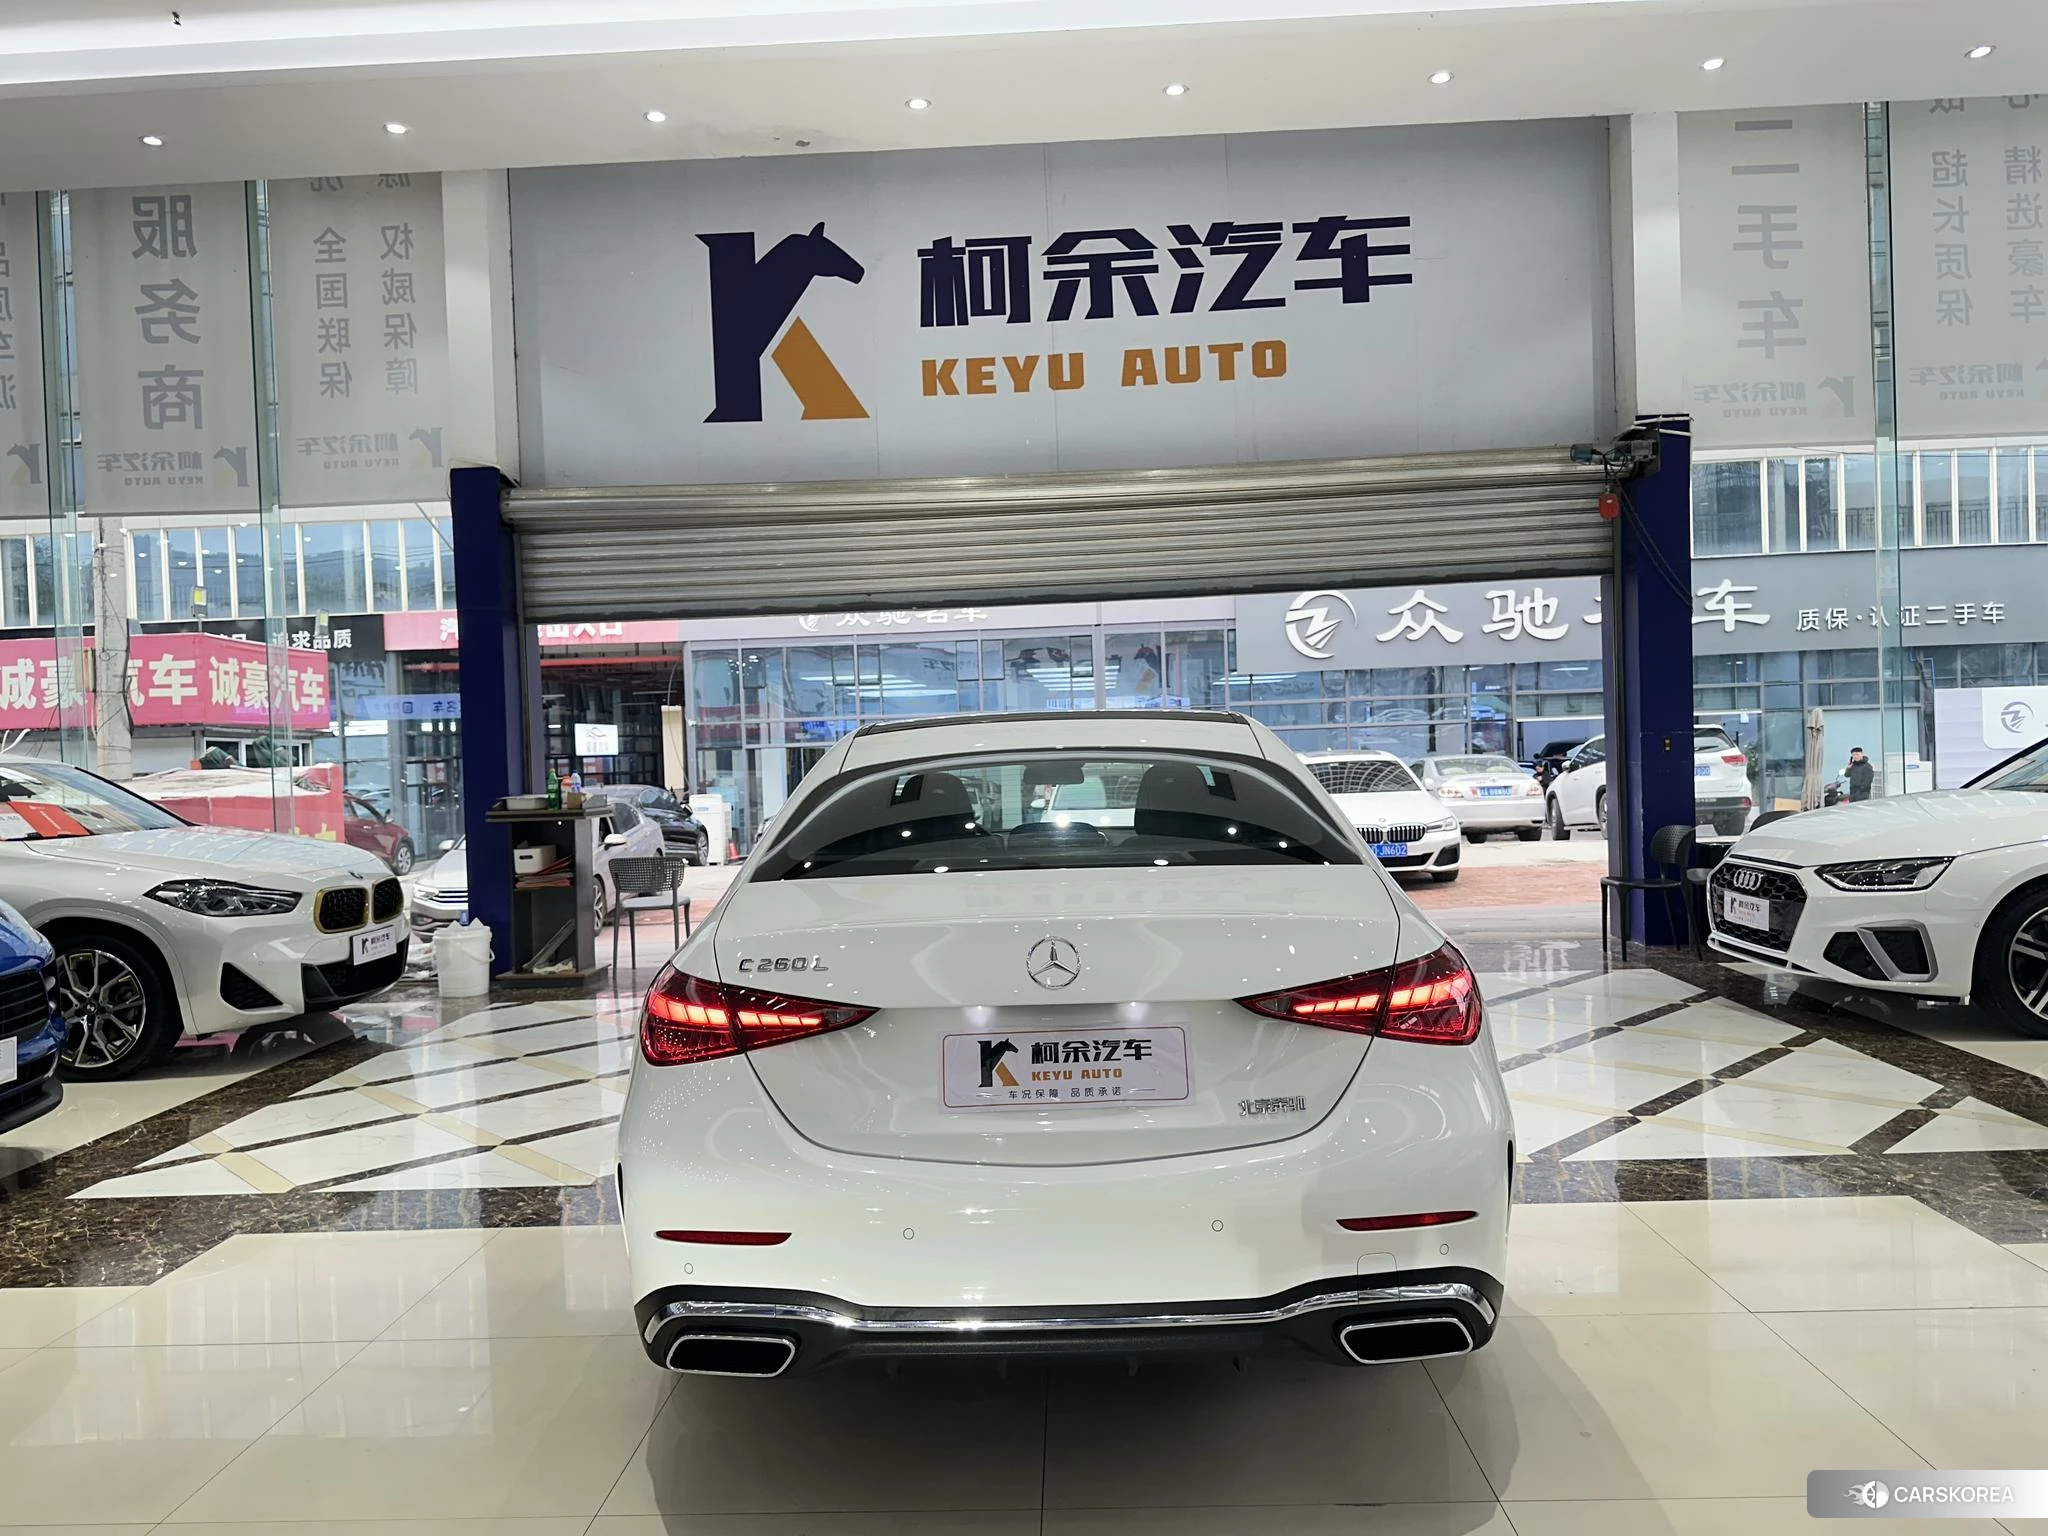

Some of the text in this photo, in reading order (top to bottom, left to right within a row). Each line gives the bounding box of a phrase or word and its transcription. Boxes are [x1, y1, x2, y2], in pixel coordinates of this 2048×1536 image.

[917, 215, 1413, 328] 柯余汽车
[921, 340, 1287, 397] KEYU AUTO
[209, 656, 326, 713] 诚豪汽车
[1031, 1039, 1153, 1065] 柯余汽车
[1008, 1085, 1123, 1100] 车况保障 品质承诺
[1031, 1068, 1123, 1082] KEYU AUTO
